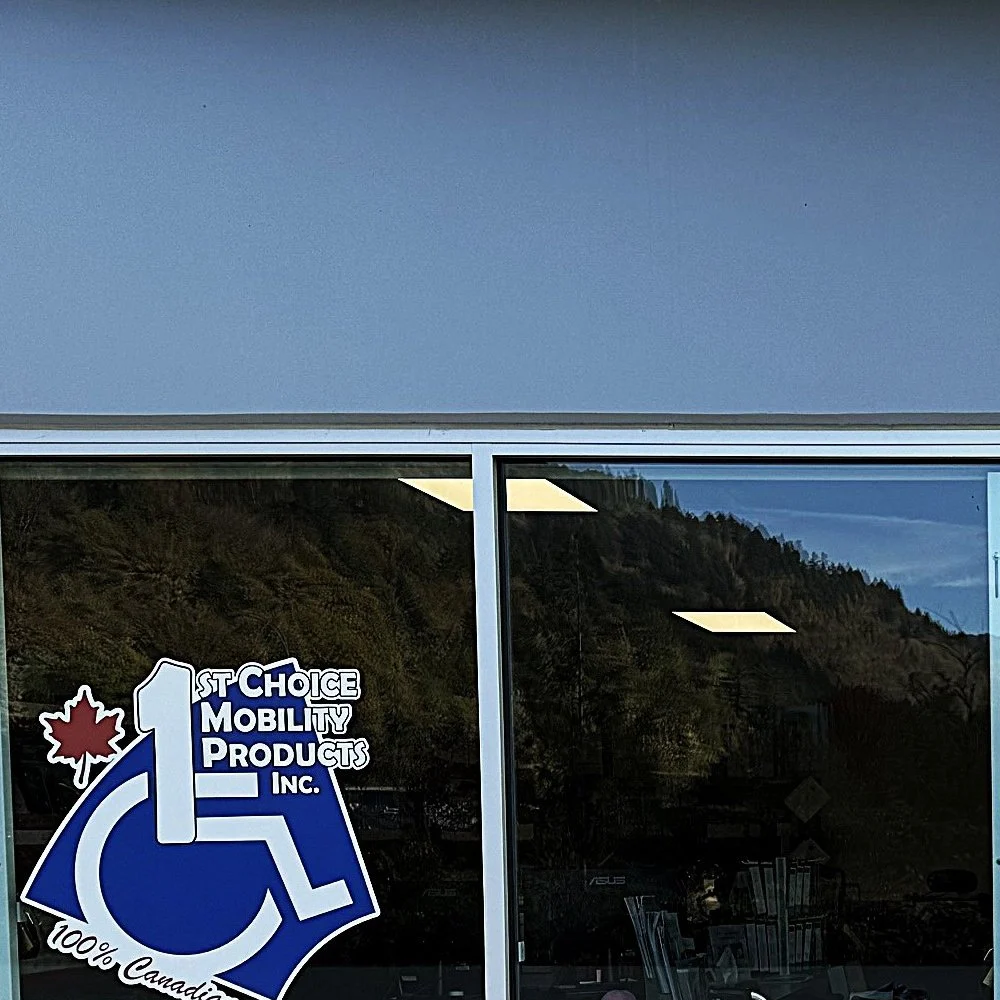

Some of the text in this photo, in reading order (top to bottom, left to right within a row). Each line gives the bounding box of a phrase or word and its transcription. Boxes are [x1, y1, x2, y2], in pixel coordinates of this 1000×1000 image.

[201, 702, 351, 733] MOBILITY
[203, 737, 369, 768] PRODUCTS
[589, 876, 626, 886] ASUS
[52, 925, 118, 966] 100%
